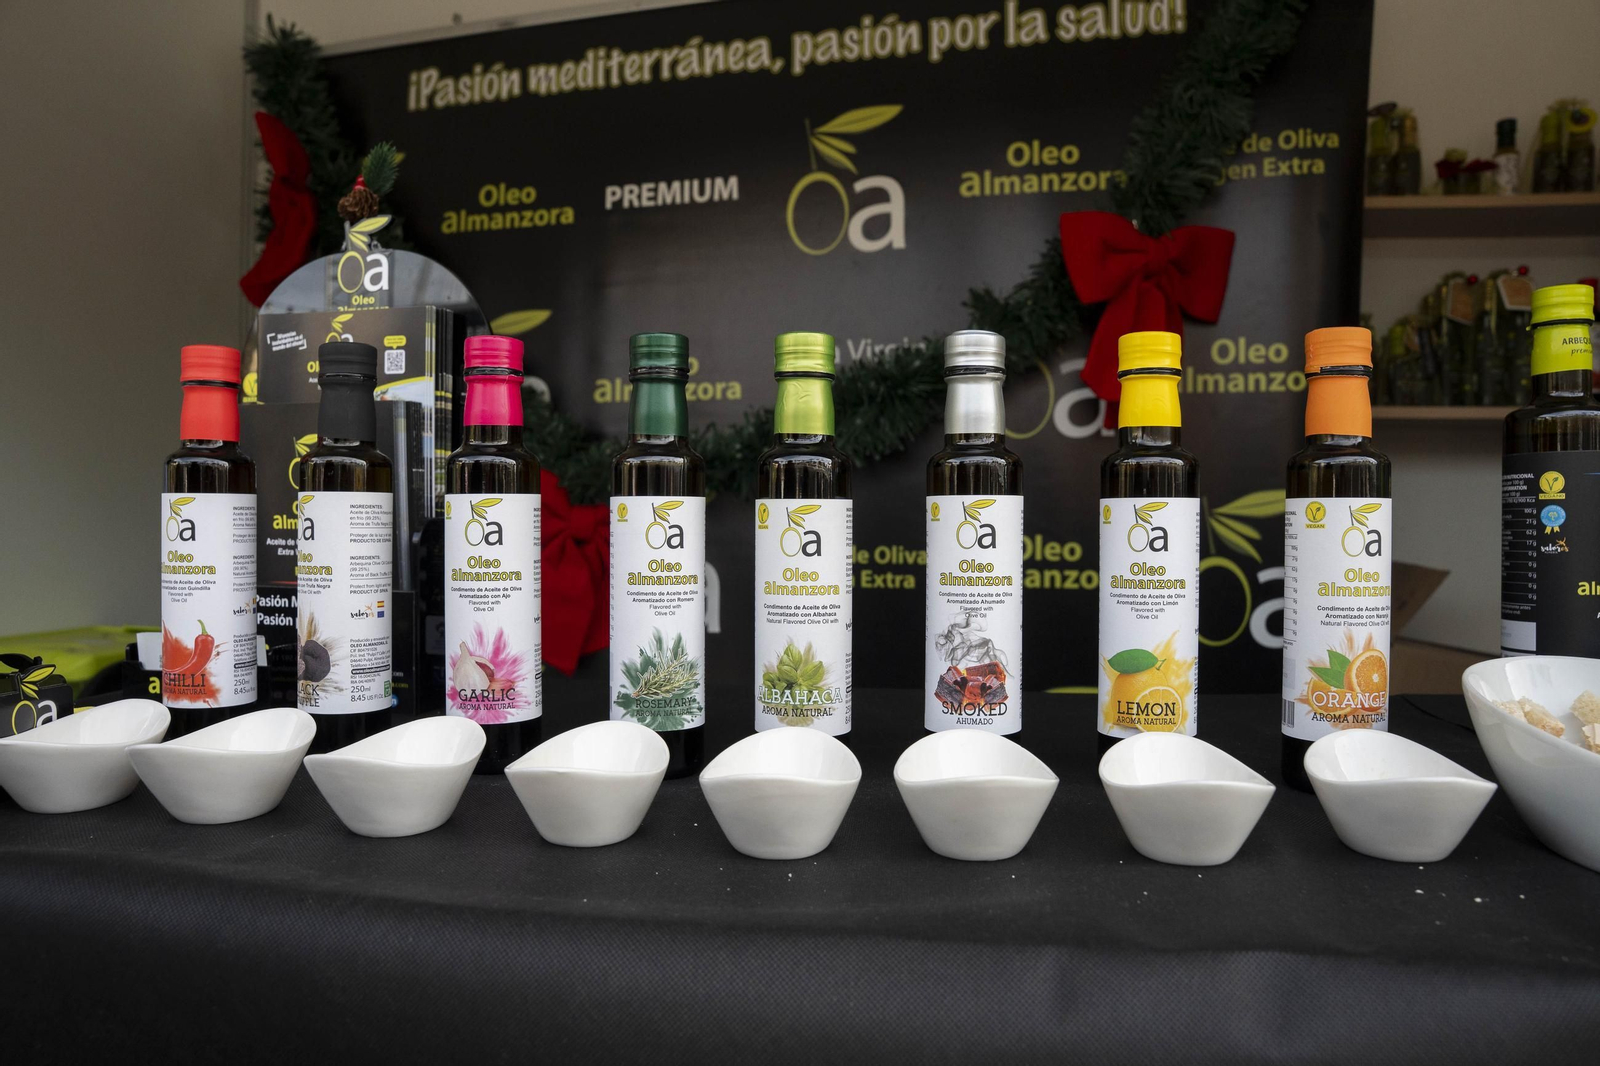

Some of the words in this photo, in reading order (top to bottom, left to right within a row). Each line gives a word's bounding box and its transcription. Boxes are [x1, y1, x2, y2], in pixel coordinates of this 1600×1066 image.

[407, 64, 521, 112] ¡Pasión
[528, 36, 783, 95] mediterránea,
[790, 14, 922, 75] pasión
[928, 10, 1000, 61] por
[1004, 0, 1047, 46] la
[1055, 0, 1189, 40] salud!
[1243, 132, 1272, 154] de
[1277, 129, 1340, 152] Oliva
[1006, 141, 1081, 168] Oleo
[1263, 157, 1325, 179] Extra
[479, 184, 537, 207] Oleo
[604, 176, 739, 210] PREMIUM
[441, 206, 574, 235] almanzora
[352, 295, 375, 305] Oleo
[1211, 337, 1288, 366] Oleo
[1179, 365, 1306, 394] lmanzo
[167, 550, 194, 563] Oleo
[277, 547, 294, 556] Extra
[874, 545, 926, 566] Oliva
[467, 556, 501, 569] Oleo
[648, 559, 682, 572] Oleo
[959, 559, 994, 573] Oleo
[1130, 562, 1166, 576] Oleo
[451, 568, 522, 582] almanzora
[627, 572, 698, 585] almanzora
[782, 567, 820, 582] Oleo
[861, 570, 915, 589] Extra
[939, 572, 1012, 586] almanzora
[1344, 568, 1380, 582] Oleo
[764, 581, 840, 596] almanzora
[1110, 575, 1186, 589] almanzora
[257, 612, 293, 627] Pasión
[163, 673, 206, 687] CHILLI
[351, 686, 371, 694] 250ml
[458, 688, 515, 702] GARLIC
[757, 686, 842, 705] ALBAHACA
[635, 697, 693, 709] ROSEMARY
[1312, 691, 1386, 708] ORANGE
[635, 709, 661, 717] AROMA
[663, 708, 693, 716] NATURAL
[762, 705, 788, 717] AROMA
[791, 707, 833, 717] NATURAL
[942, 701, 1007, 716] SMOKED
[1117, 700, 1175, 716] LEMON
[1116, 716, 1142, 724] AROMA
[1144, 717, 1176, 725] NATURAL
[1311, 712, 1349, 723] AROMA
[1353, 713, 1386, 723] NATURAL
